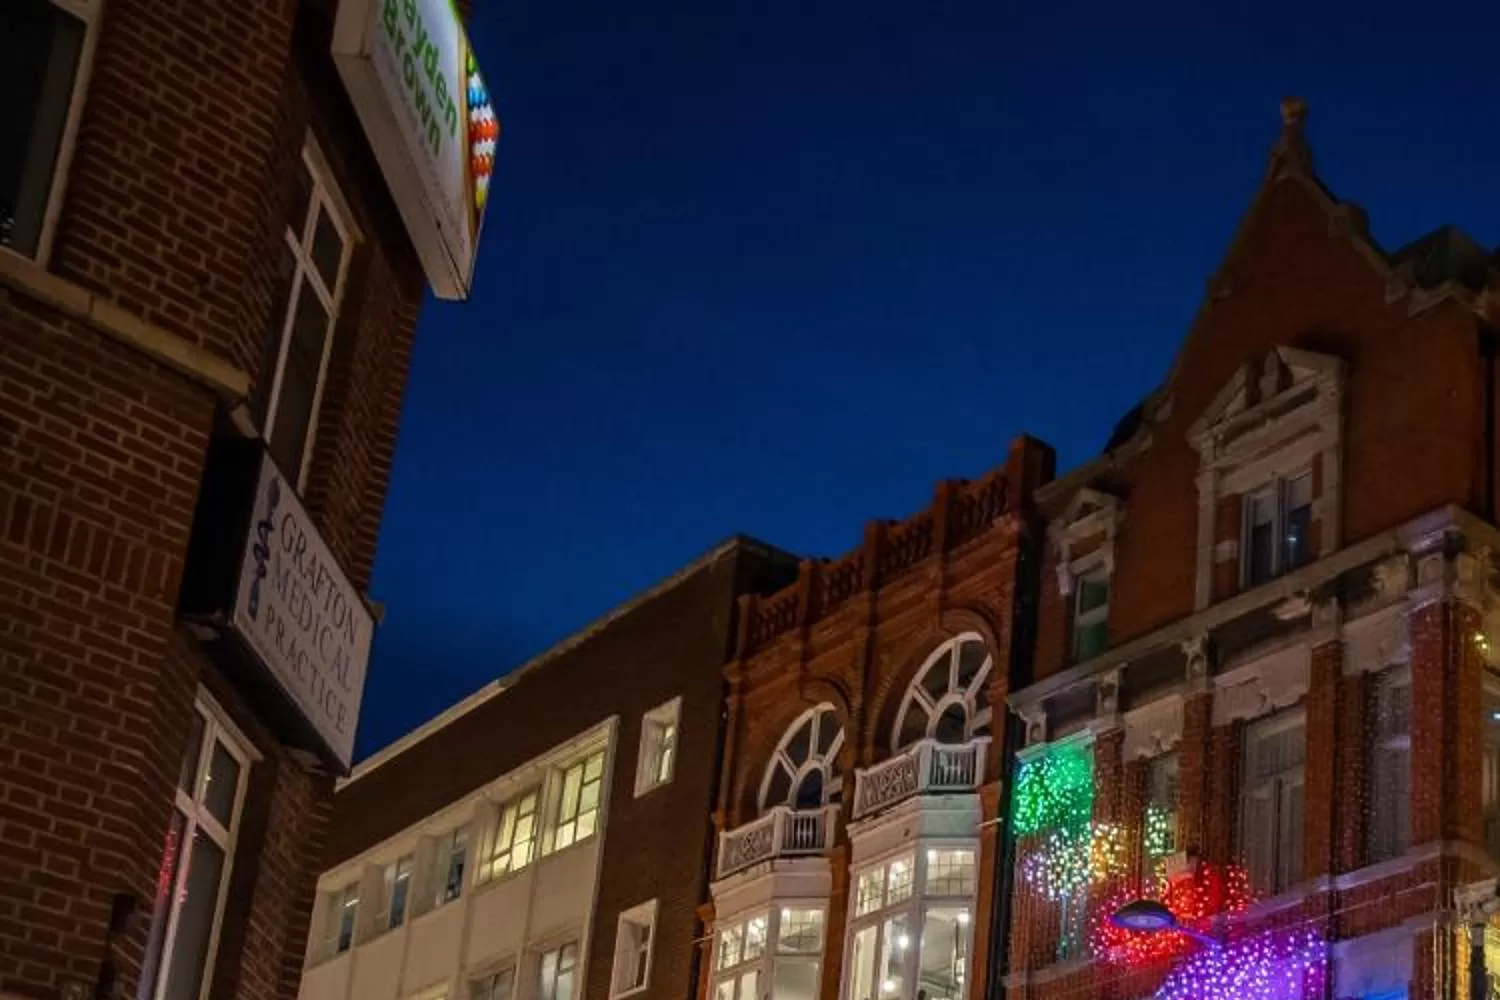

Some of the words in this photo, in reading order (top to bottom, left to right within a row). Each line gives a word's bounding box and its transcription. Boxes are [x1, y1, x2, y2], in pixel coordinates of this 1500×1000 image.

[270, 550, 352, 694] MEDICAL
[281, 511, 359, 646] GRAFTON
[264, 603, 348, 734] PRACTICE
